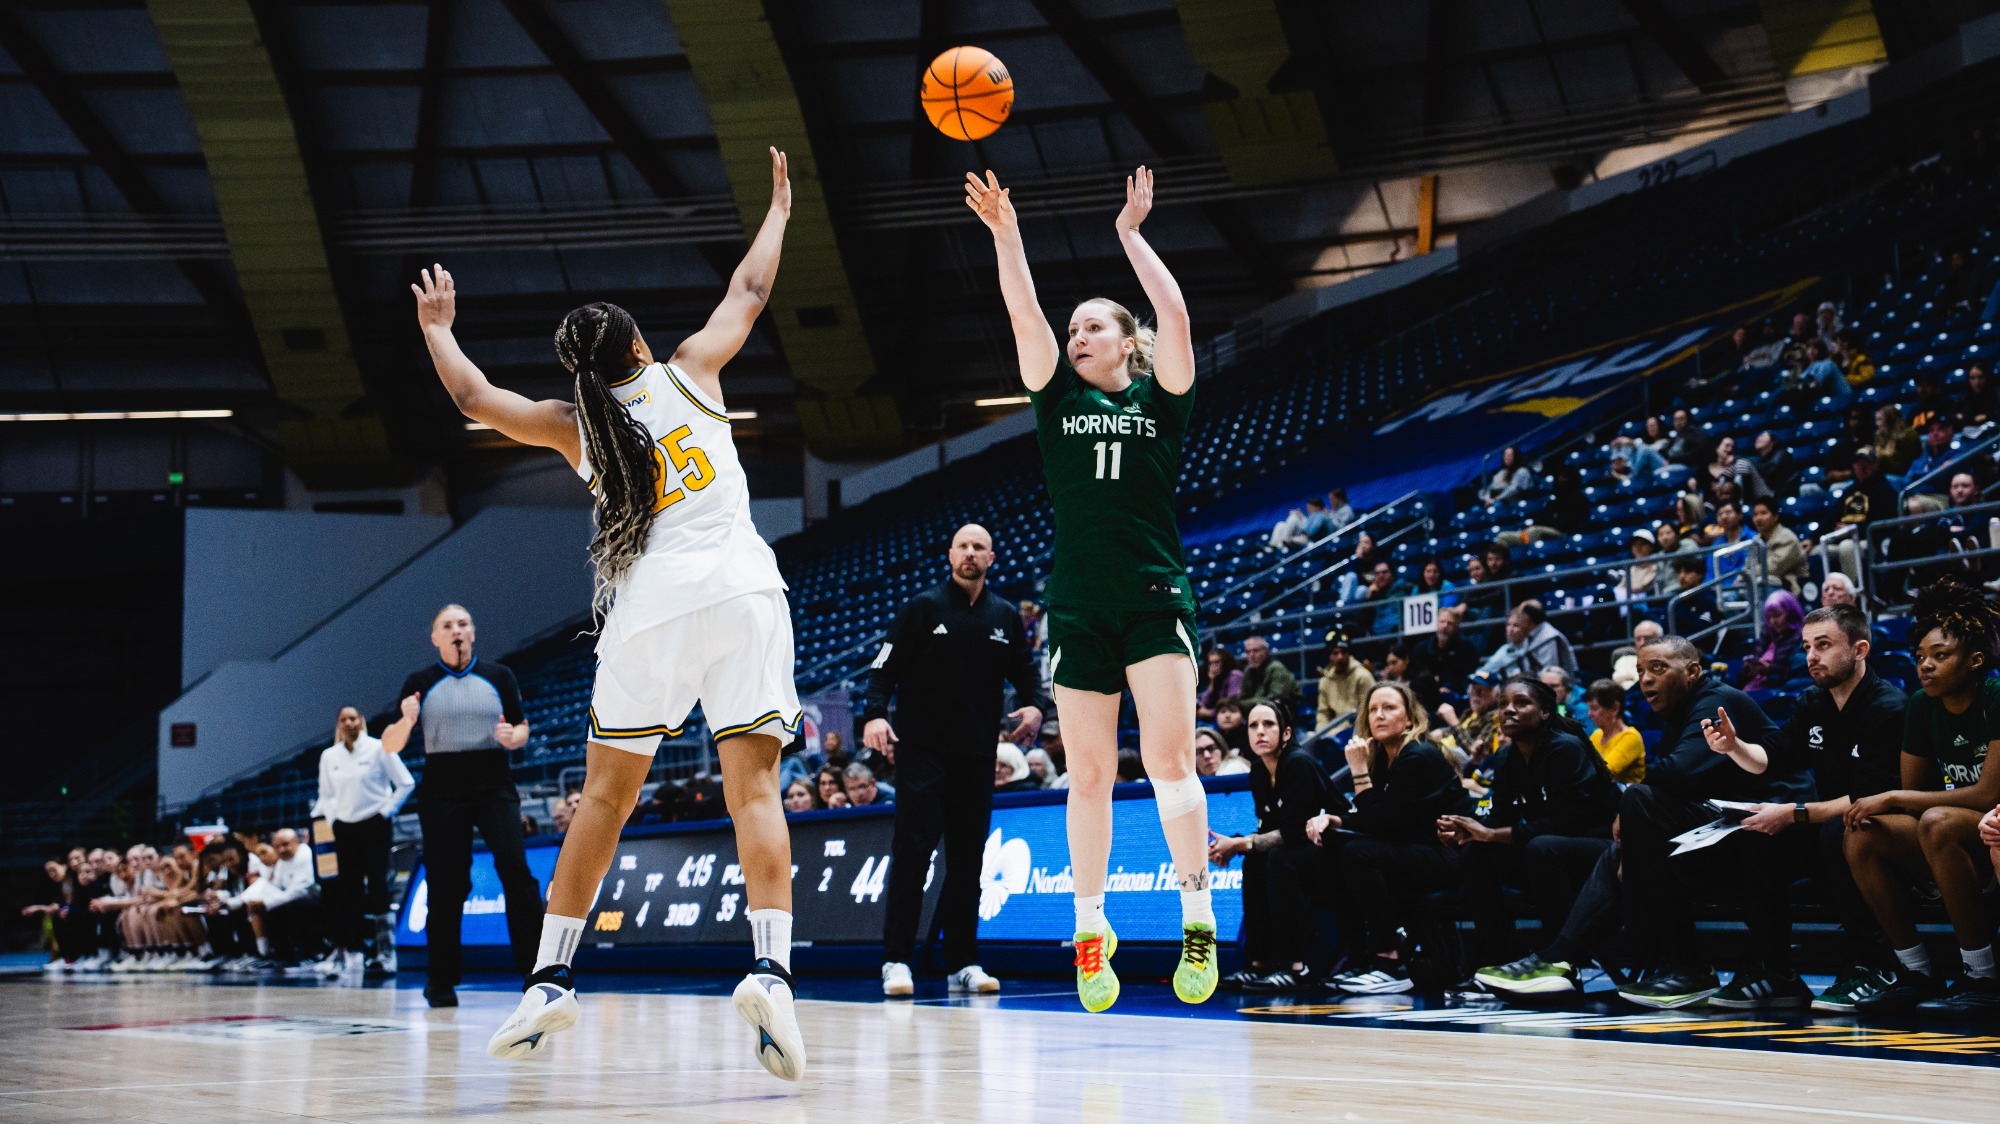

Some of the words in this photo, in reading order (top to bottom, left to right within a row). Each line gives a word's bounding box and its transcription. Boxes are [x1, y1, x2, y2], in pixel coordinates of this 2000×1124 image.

[1063, 414, 1157, 438] HORNETS
[647, 424, 716, 517] 25
[1093, 441, 1122, 480] 11
[1410, 601, 1433, 627] 116
[613, 879, 625, 900] 3
[817, 866, 832, 892] 2
[850, 855, 890, 903] 44
[1026, 865, 1074, 893] North
[635, 901, 650, 927] 4
[716, 893, 740, 921] 35
